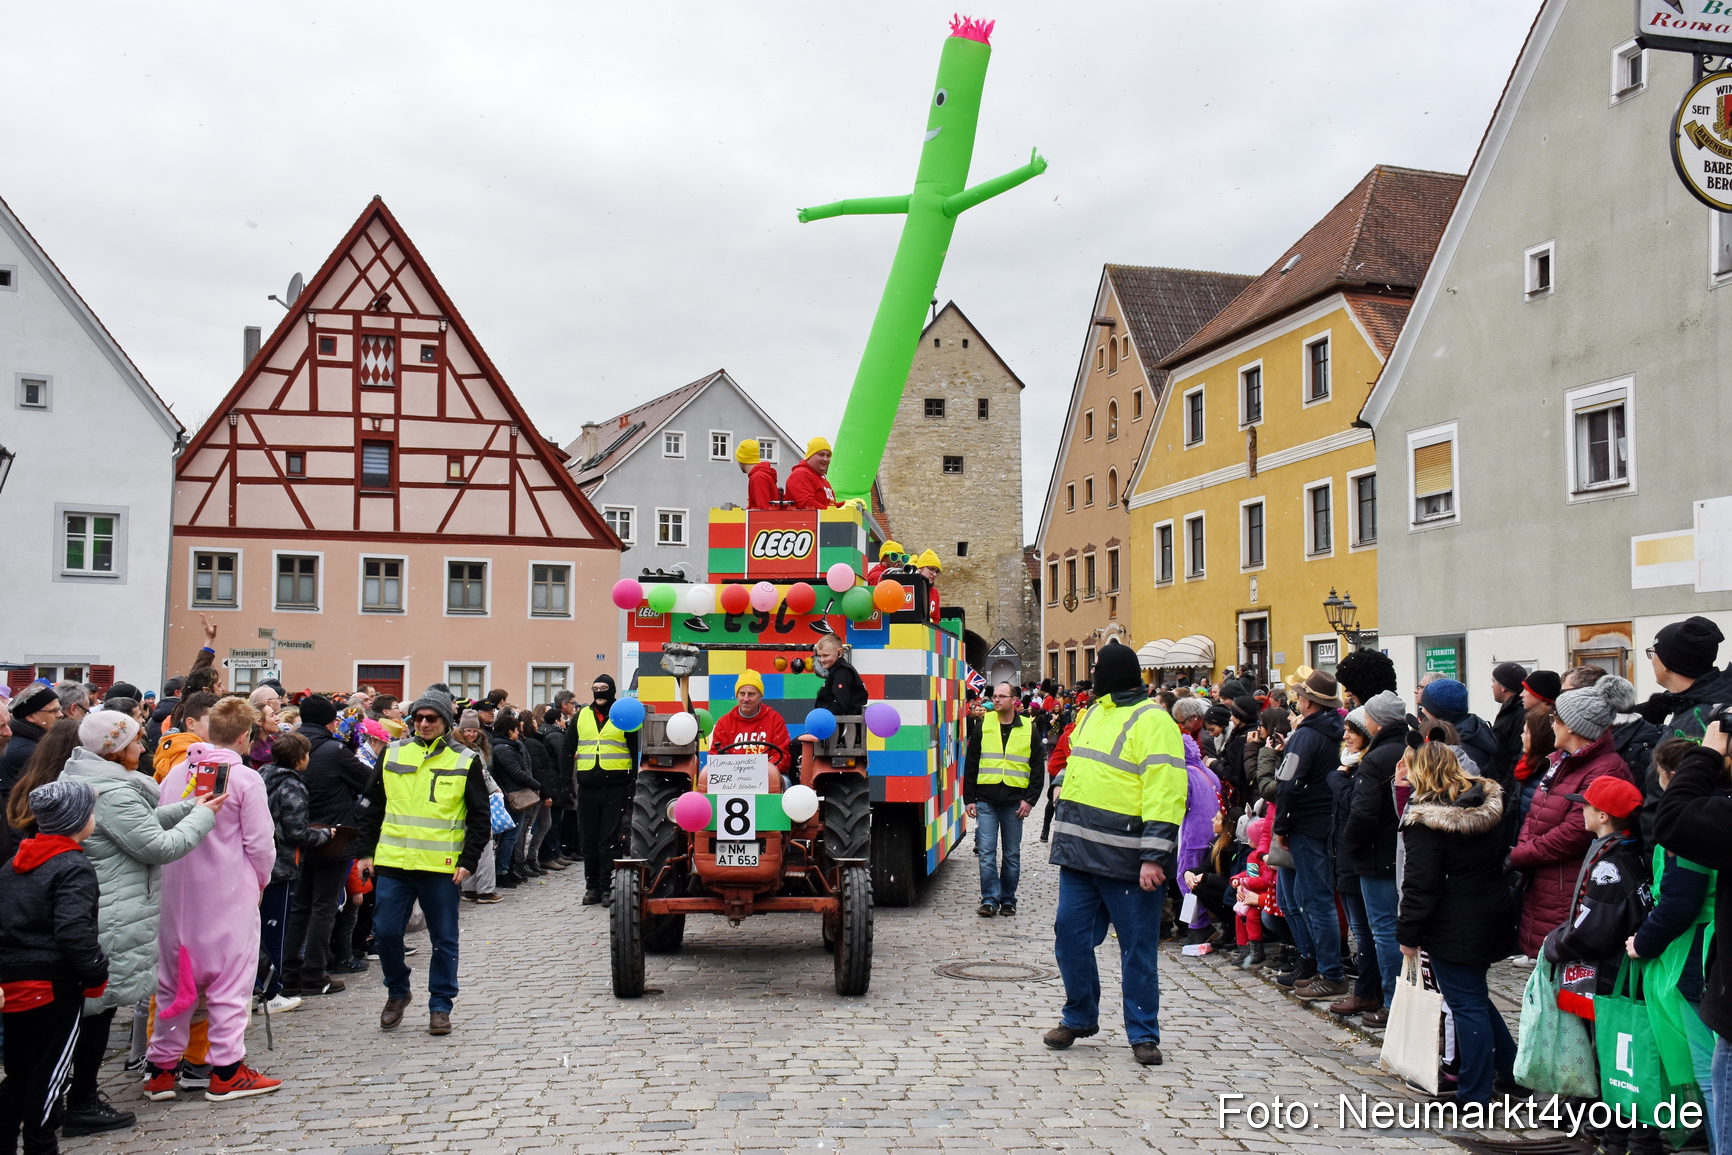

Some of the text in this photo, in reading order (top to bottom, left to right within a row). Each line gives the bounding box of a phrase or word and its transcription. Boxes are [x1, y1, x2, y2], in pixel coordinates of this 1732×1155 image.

[1648, 12, 1731, 33] Roma
[1691, 104, 1711, 116] SEIT
[1703, 159, 1732, 175] BÄRE
[753, 531, 813, 558] LEGO
[638, 607, 661, 618] LEGO
[232, 649, 268, 658] Forstergasse
[1319, 644, 1335, 656] BW
[1432, 648, 1456, 656] VERMIETEN
[709, 757, 757, 767] Klimawandel
[709, 774, 733, 784] BIER
[723, 797, 751, 836] 8
[728, 844, 746, 855] NM
[718, 855, 758, 866] AT 653
